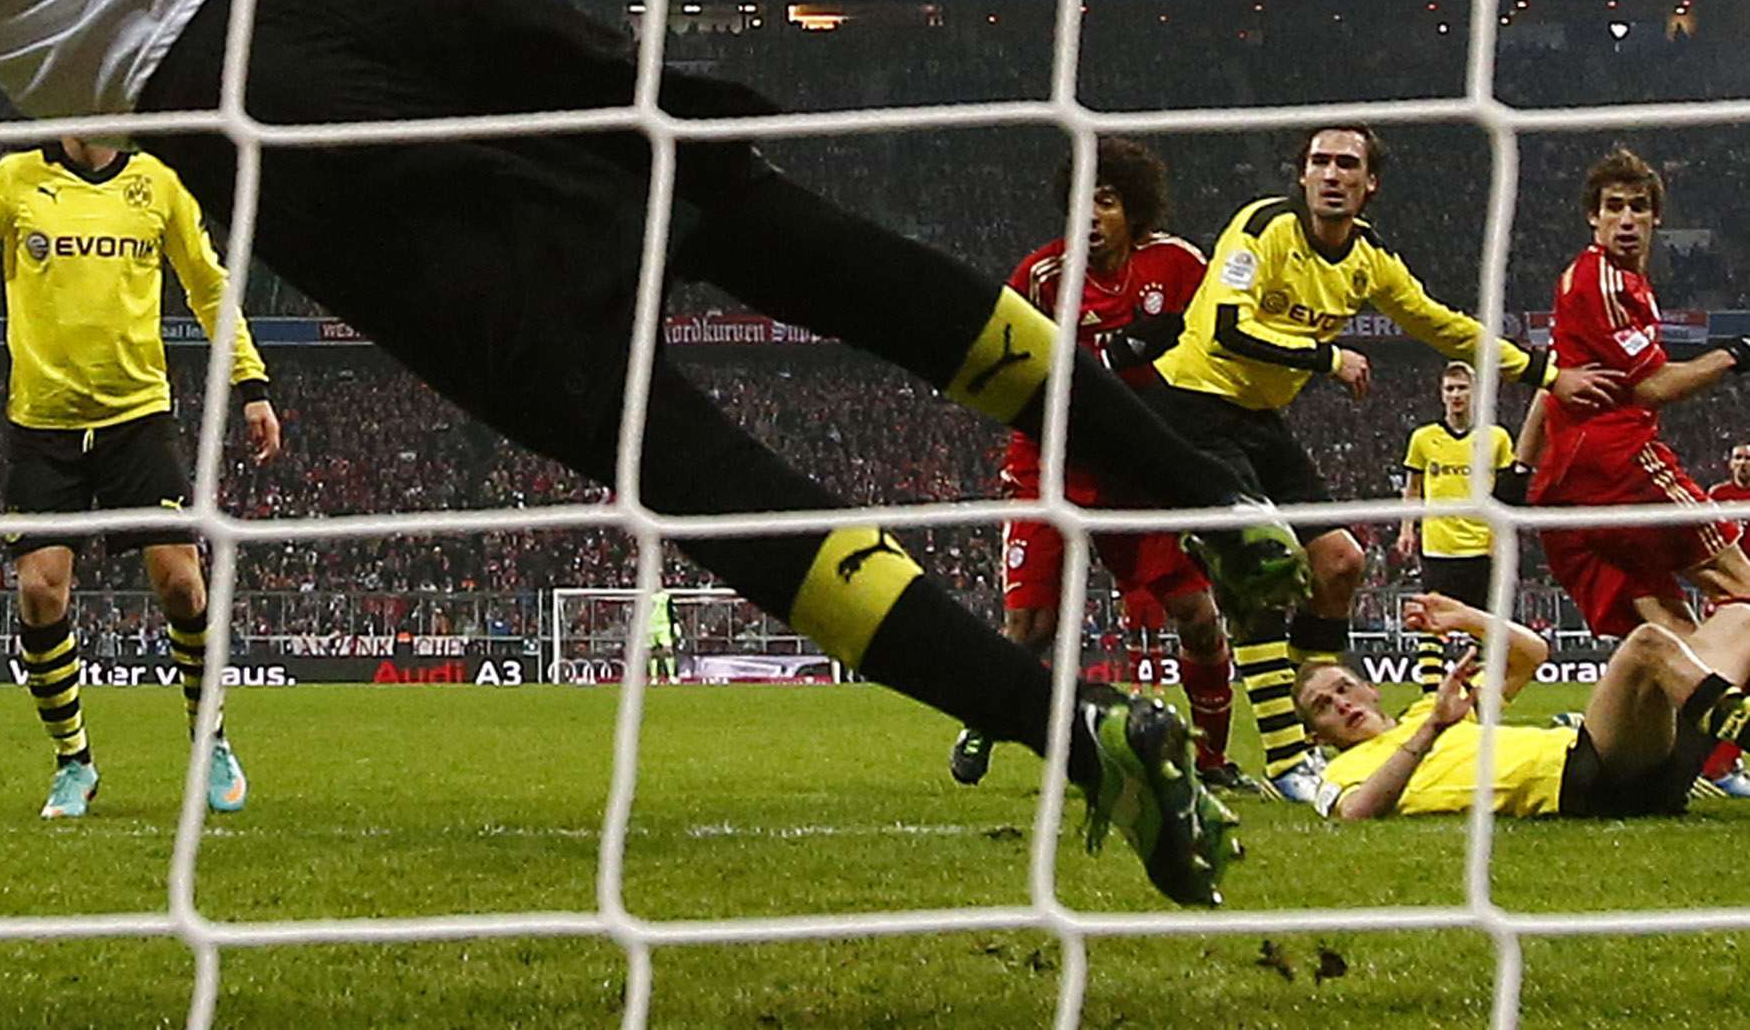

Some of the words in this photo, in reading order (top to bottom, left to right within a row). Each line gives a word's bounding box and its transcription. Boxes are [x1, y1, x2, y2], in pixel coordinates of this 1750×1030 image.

[55, 235, 156, 259] EVONIK
[155, 665, 297, 686] vaus.
[373, 661, 465, 684] Audi
[475, 661, 522, 686] A3
